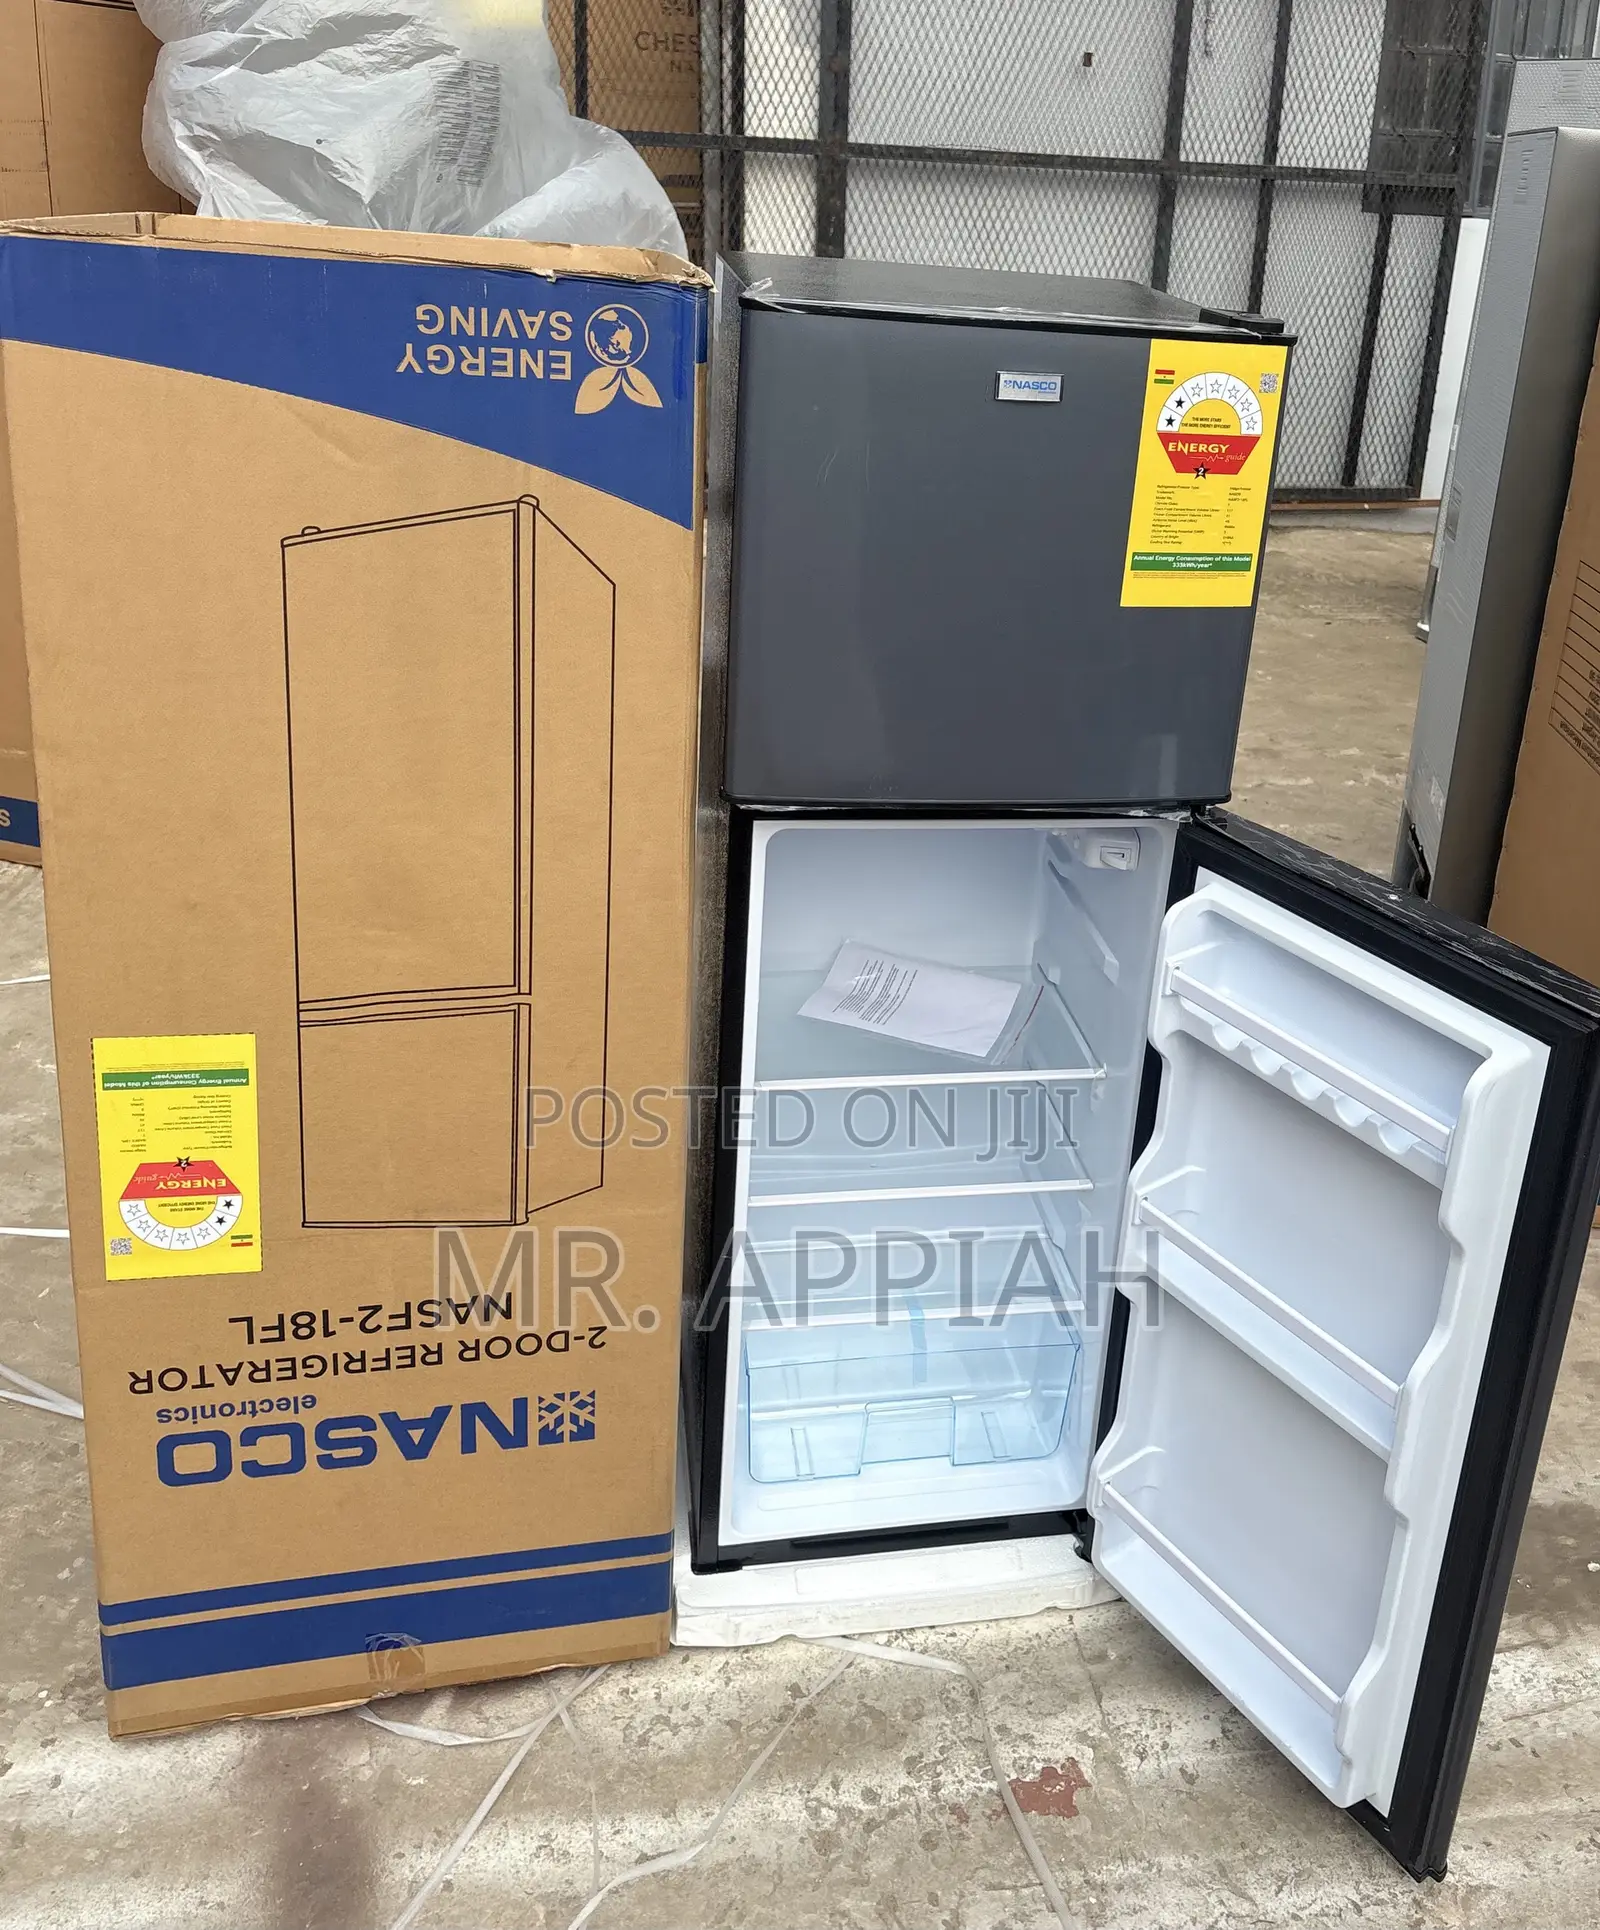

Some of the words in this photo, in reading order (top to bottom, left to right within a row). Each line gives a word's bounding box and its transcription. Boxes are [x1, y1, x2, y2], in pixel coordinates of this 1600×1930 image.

[416, 303, 573, 341] SAVING
[396, 348, 573, 381] ENERGY
[1012, 380, 1057, 391] NASCO
[1168, 440, 1230, 455] ENERGY
[1225, 453, 1246, 462] guide
[1198, 467, 1204, 475] 2
[180, 1159, 187, 1167] 2
[155, 1173, 226, 1190] ENERGY
[228, 1291, 515, 1346] NASF2-18FL
[458, 1325, 608, 1363] 2-DOOR
[128, 1344, 444, 1396] REFRIGERATOR
[156, 1394, 318, 1424] electronics
[156, 1397, 530, 1488] NASCO
